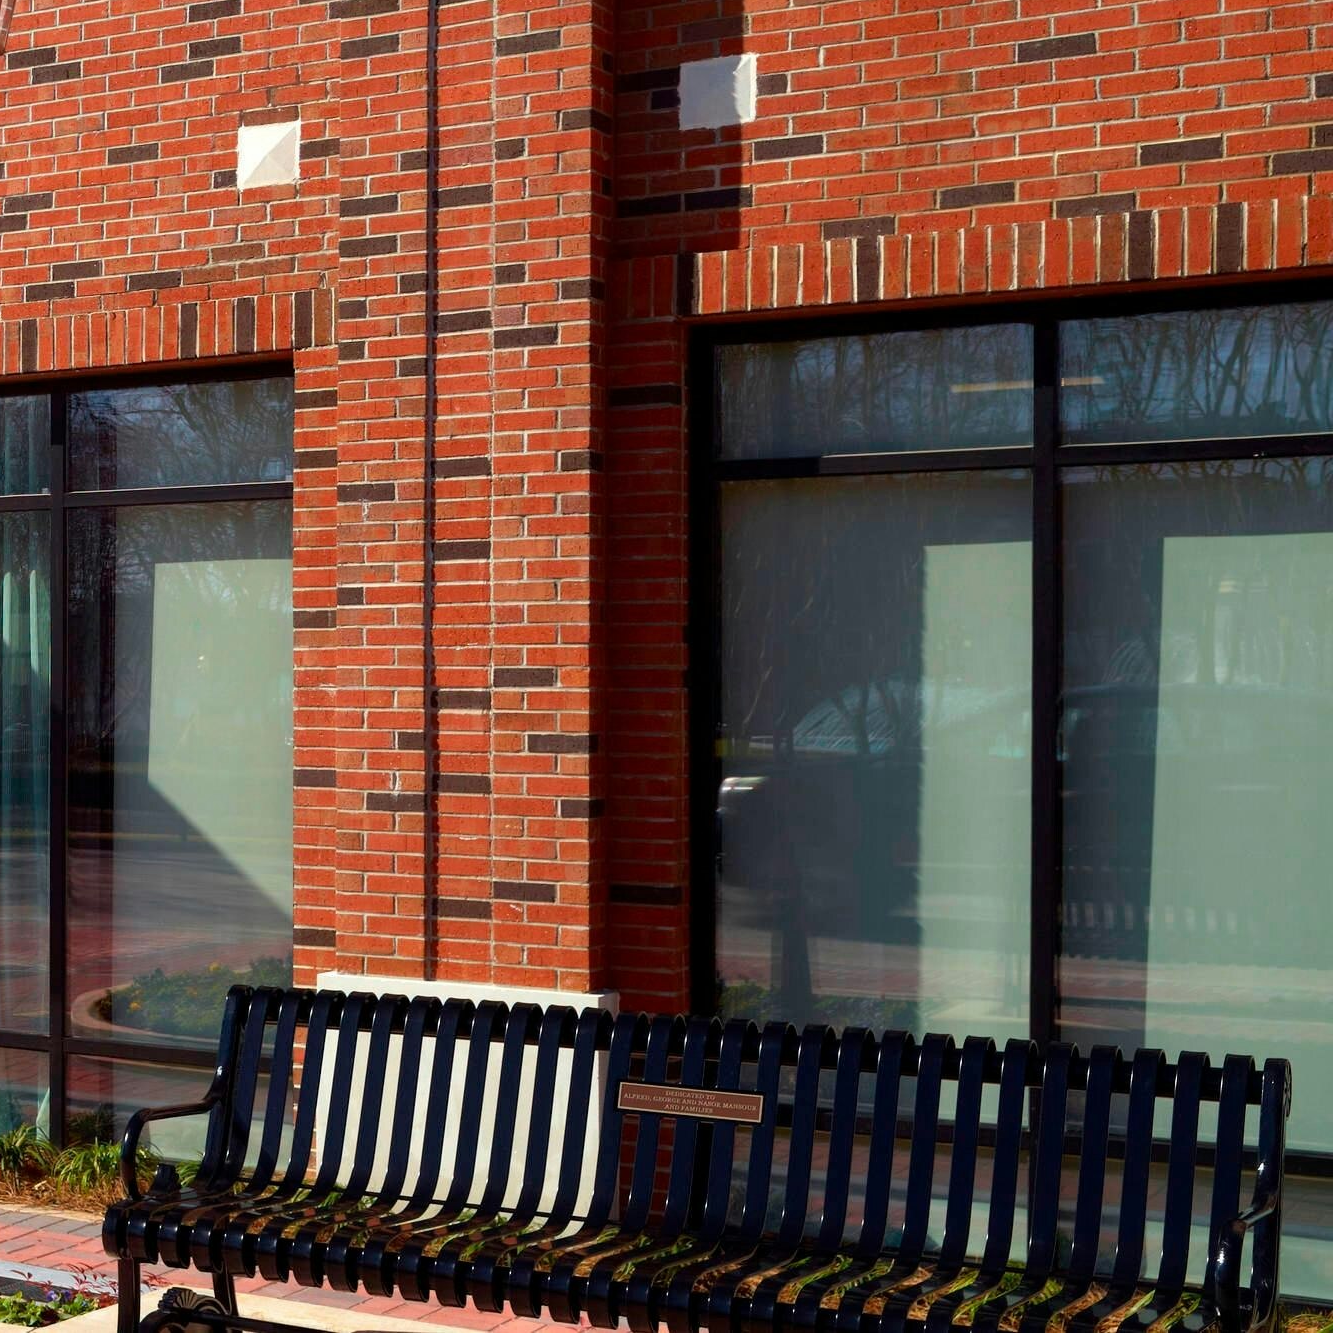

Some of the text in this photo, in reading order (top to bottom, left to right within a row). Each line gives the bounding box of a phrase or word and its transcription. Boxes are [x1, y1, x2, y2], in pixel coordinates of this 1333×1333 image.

[665, 1090, 706, 1100] DEDICATED
[652, 1096, 680, 1104] GEORGE
[680, 1106, 714, 1114] FAMILIES
